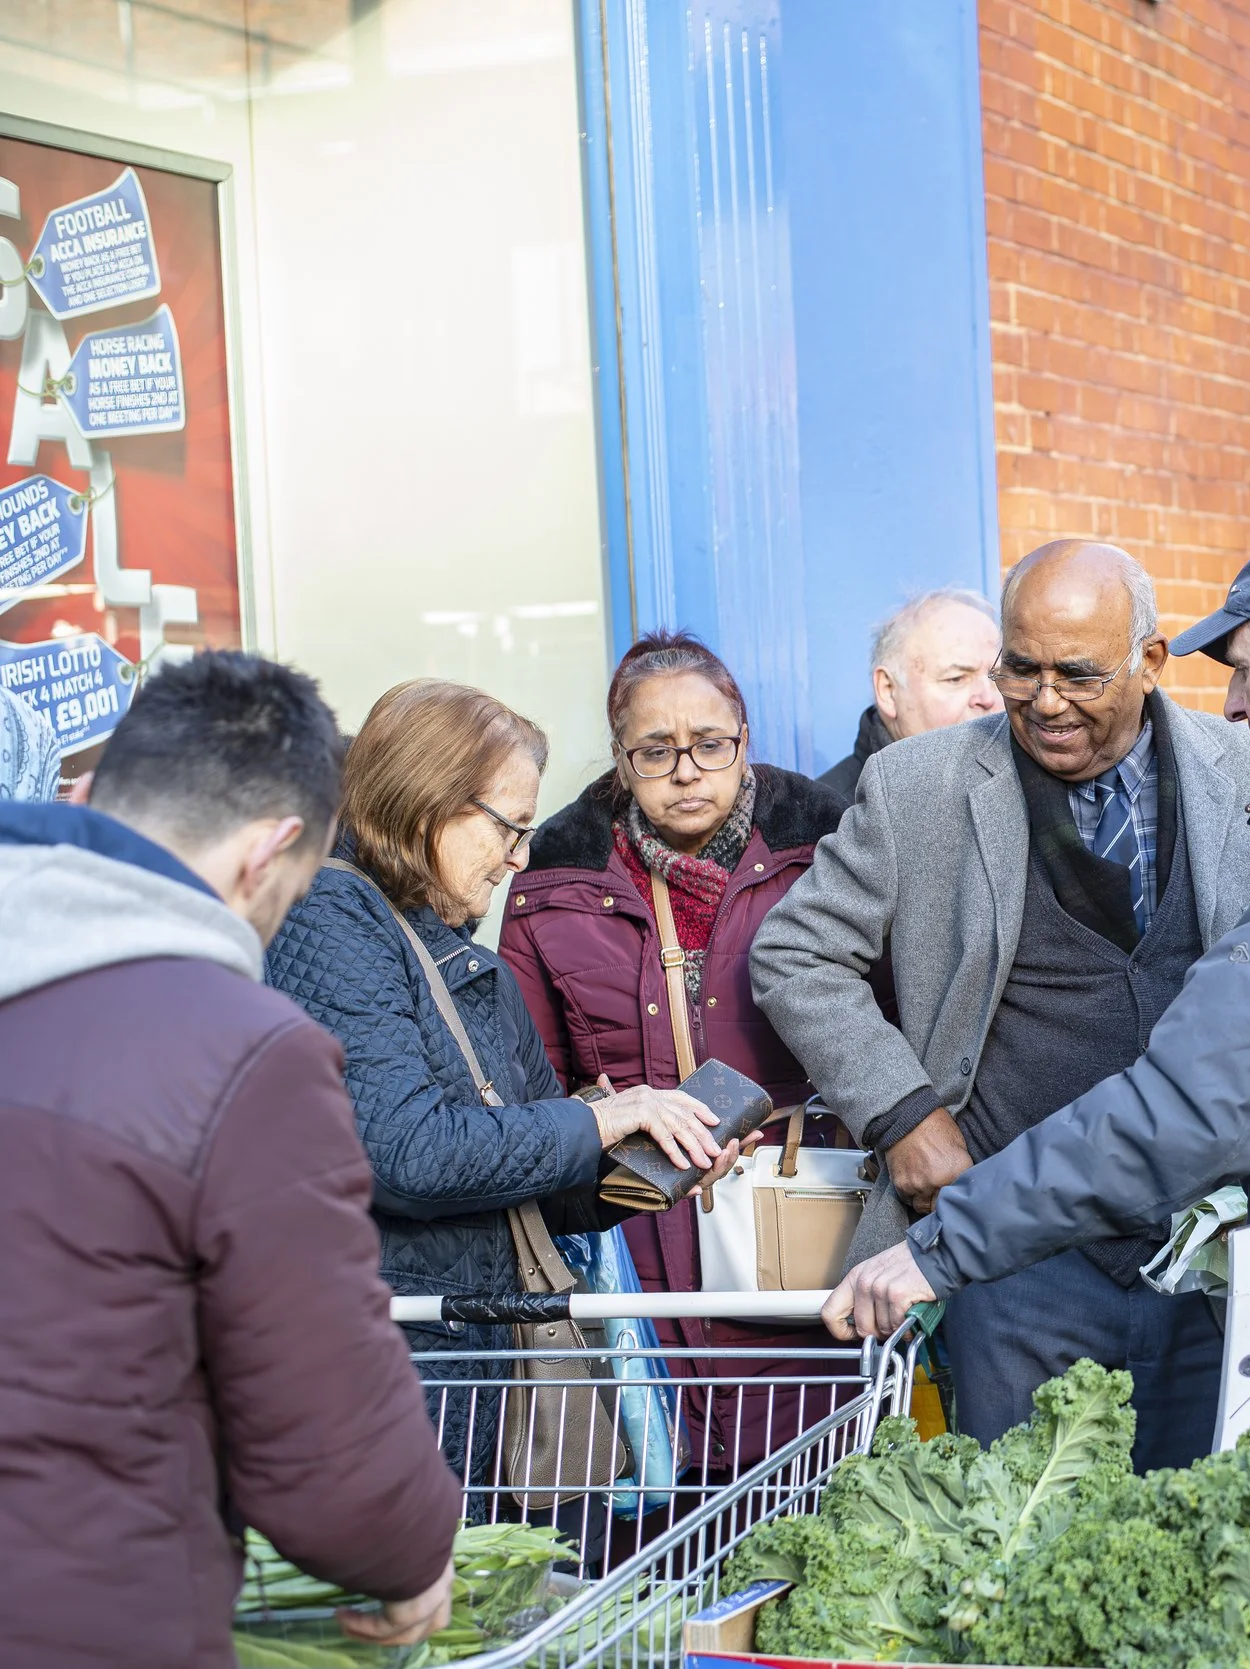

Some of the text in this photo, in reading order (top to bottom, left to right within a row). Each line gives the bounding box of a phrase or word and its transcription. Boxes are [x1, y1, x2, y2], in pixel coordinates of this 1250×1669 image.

[55, 198, 132, 239] FOOTBALL
[50, 220, 147, 263] ACCA INSURANCE
[88, 352, 173, 379] MONEY BACK
[90, 333, 165, 357] HORSE RACING
[17, 496, 61, 538] BACK
[37, 522, 60, 544] YOUR
[0, 644, 102, 689] IRISH LOTTO
[40, 685, 50, 703] 4
[51, 670, 93, 701] MATCH
[94, 668, 104, 687] 4
[57, 684, 119, 732] £9,001
